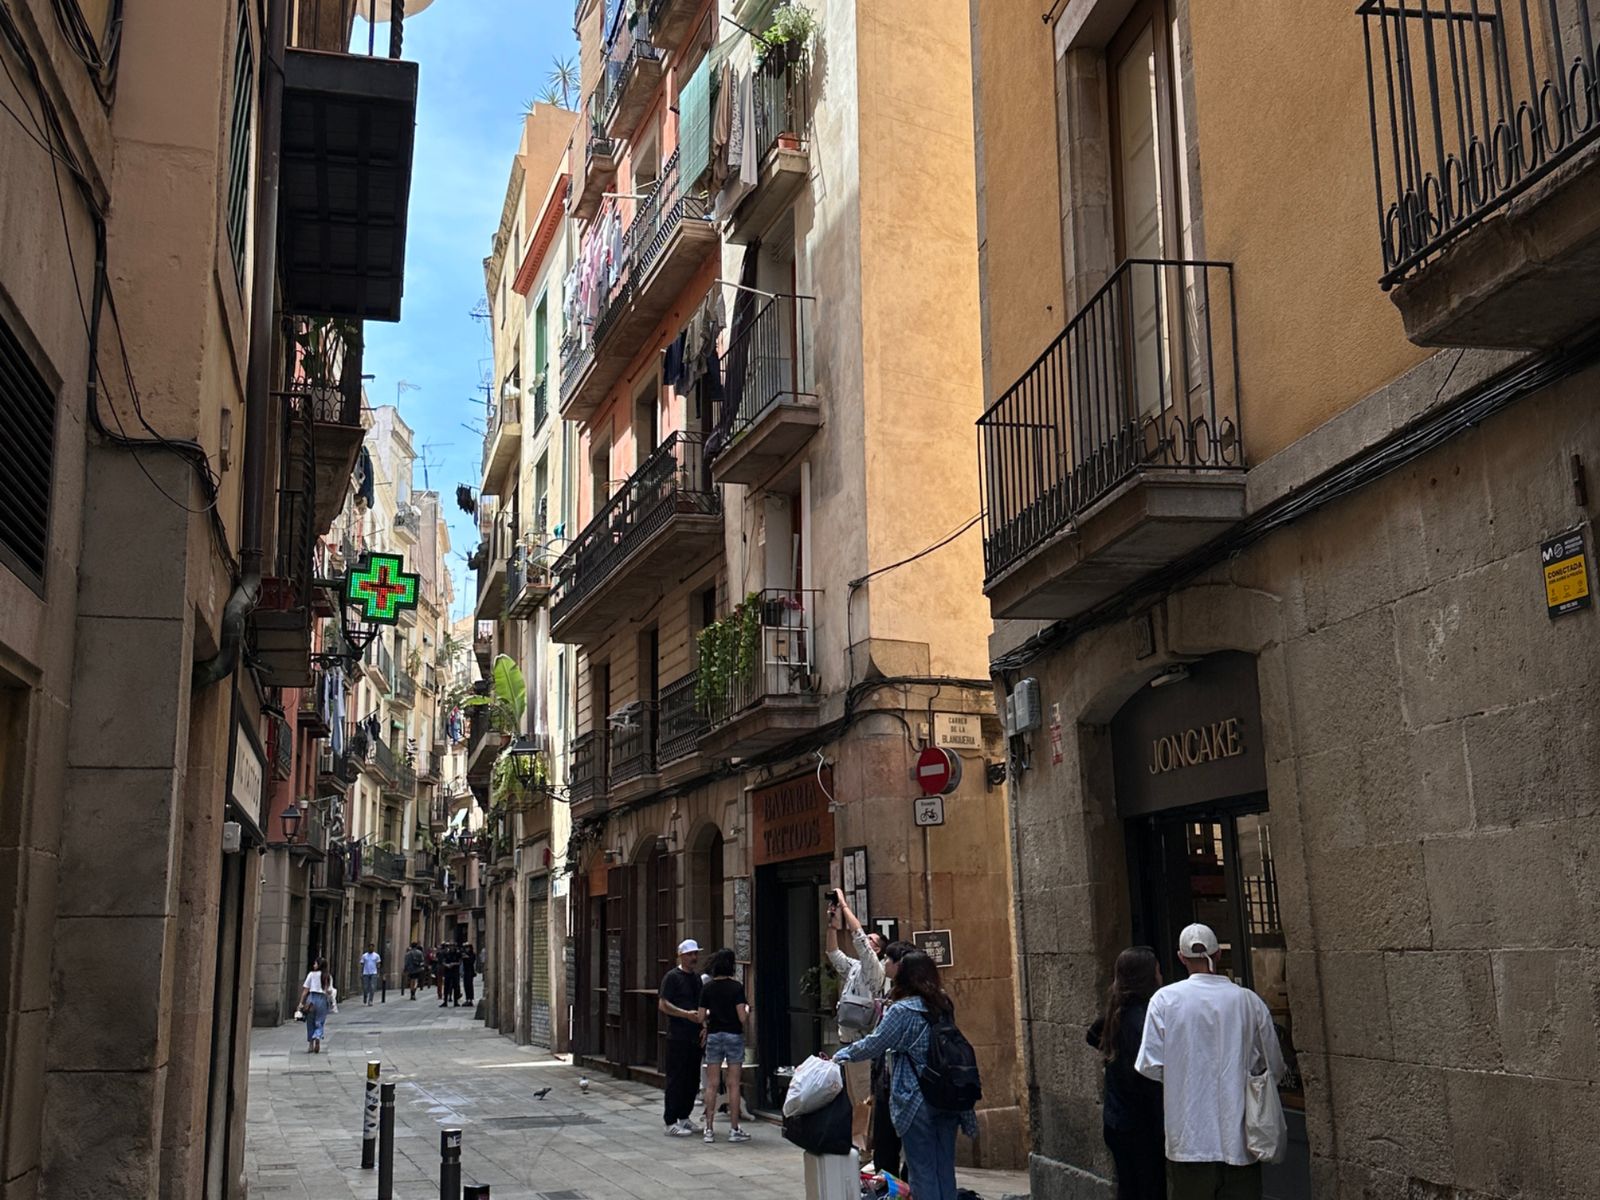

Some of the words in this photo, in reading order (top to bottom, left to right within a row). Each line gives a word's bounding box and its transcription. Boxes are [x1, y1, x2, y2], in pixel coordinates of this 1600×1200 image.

[948, 716, 968, 725] CARRER
[1149, 717, 1242, 775] JONCAKE
[763, 783, 818, 823] BAVARIA
[763, 816, 822, 857] TATTOOS
